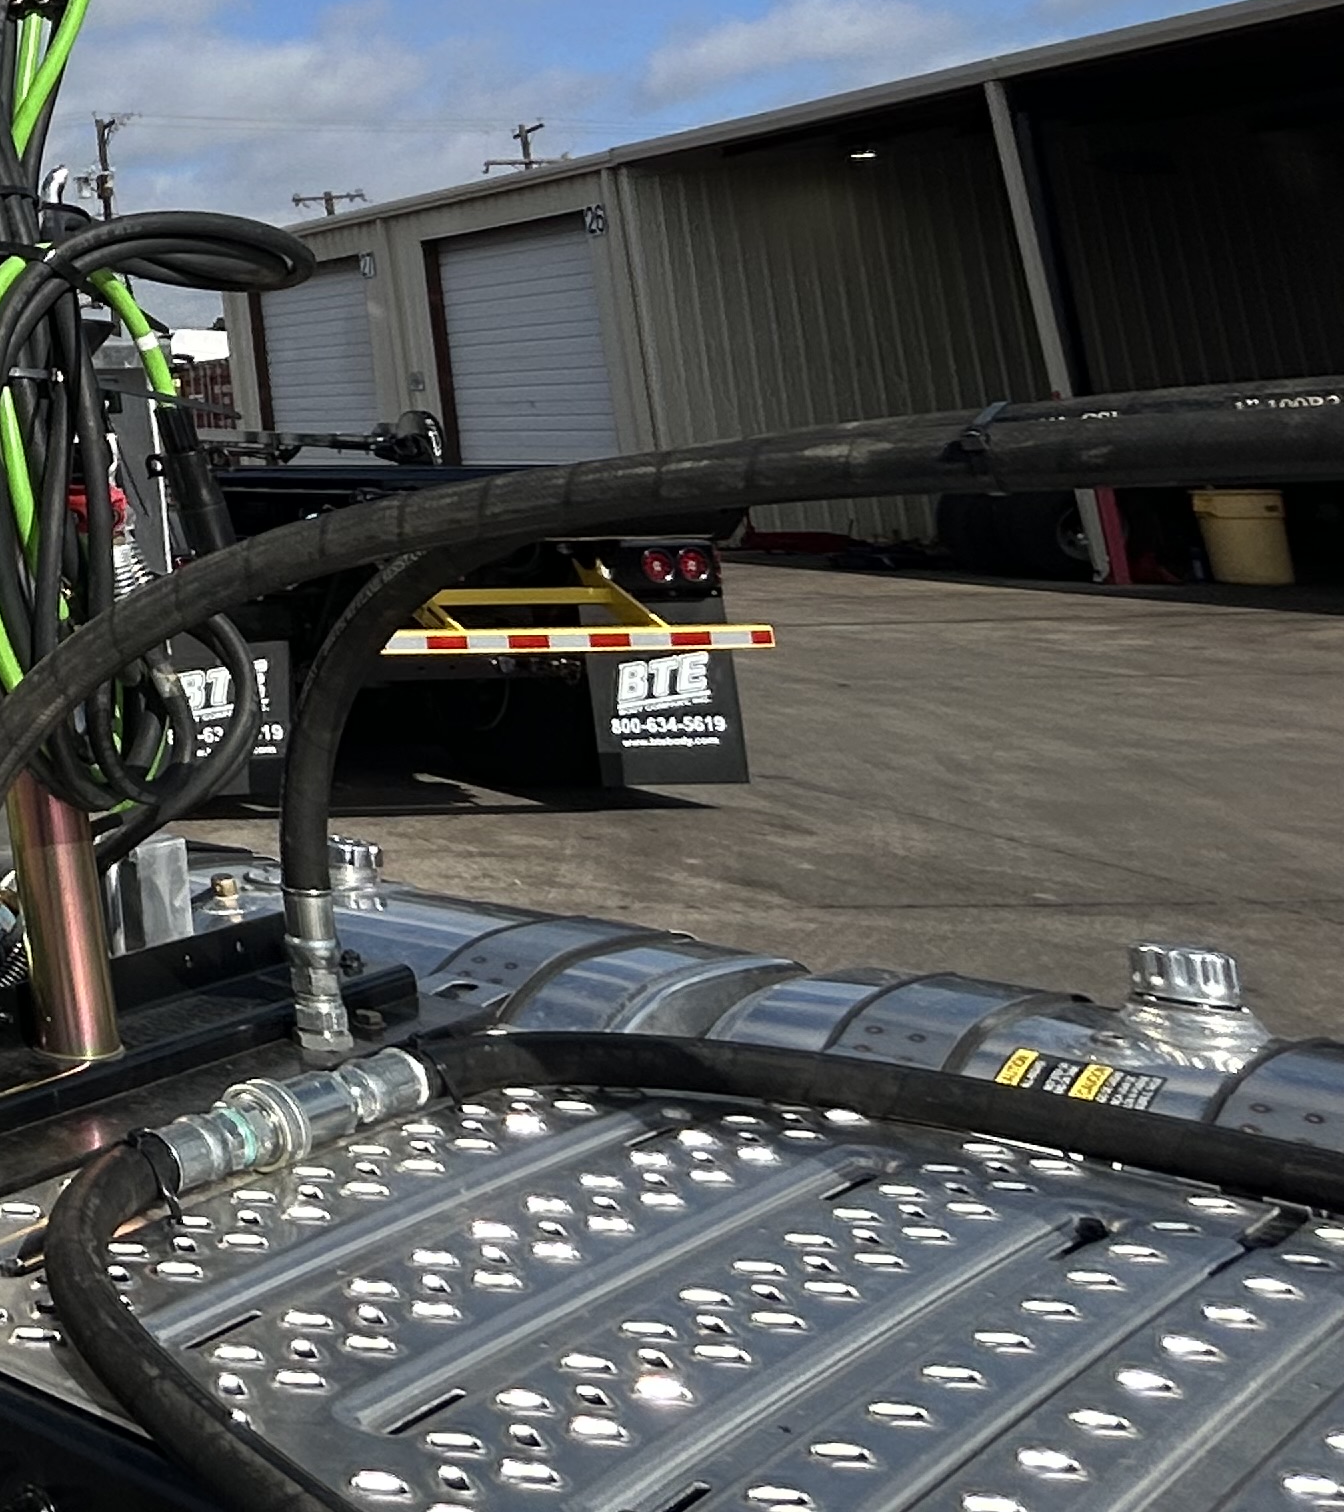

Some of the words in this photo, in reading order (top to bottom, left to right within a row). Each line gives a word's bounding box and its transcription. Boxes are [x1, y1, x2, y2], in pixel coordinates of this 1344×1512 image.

[585, 204, 604, 234] 26
[618, 651, 710, 701] BTE
[611, 715, 726, 734] 800-634-5619
